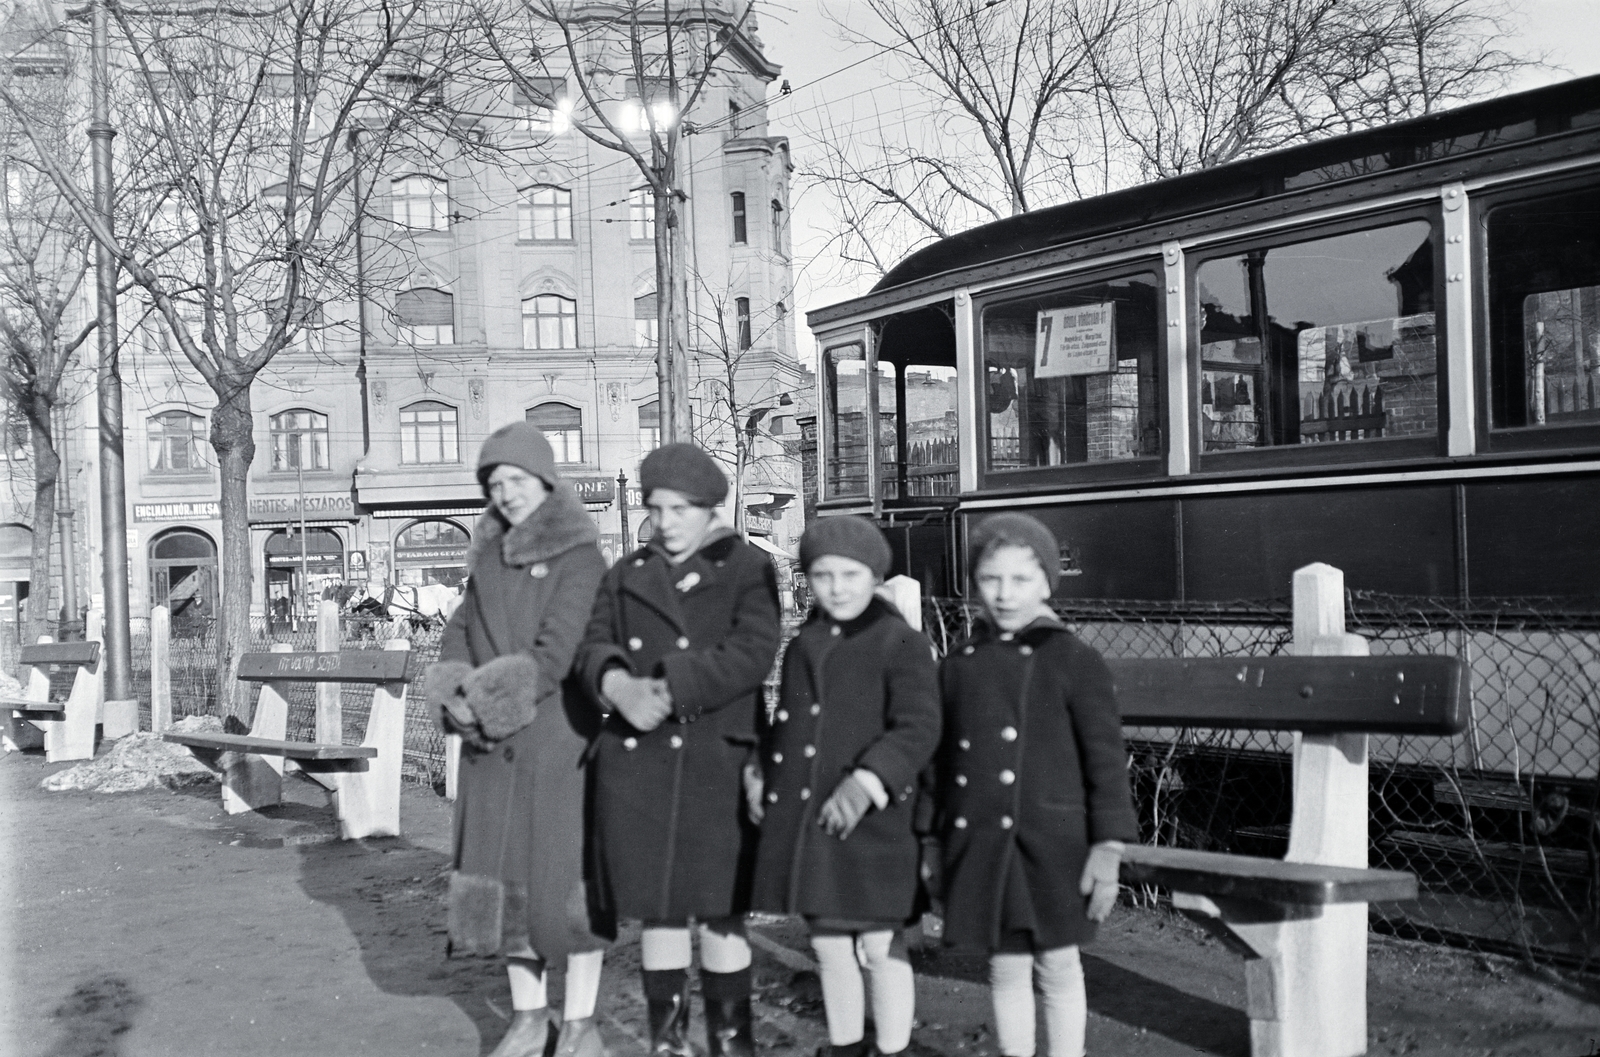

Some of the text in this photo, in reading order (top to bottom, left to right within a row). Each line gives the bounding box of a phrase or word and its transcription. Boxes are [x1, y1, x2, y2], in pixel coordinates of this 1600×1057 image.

[1040, 316, 1053, 367] 7
[573, 479, 607, 493] ÓNÉ
[249, 498, 287, 514] HENTES
[294, 496, 351, 513] MÉSZÁROS
